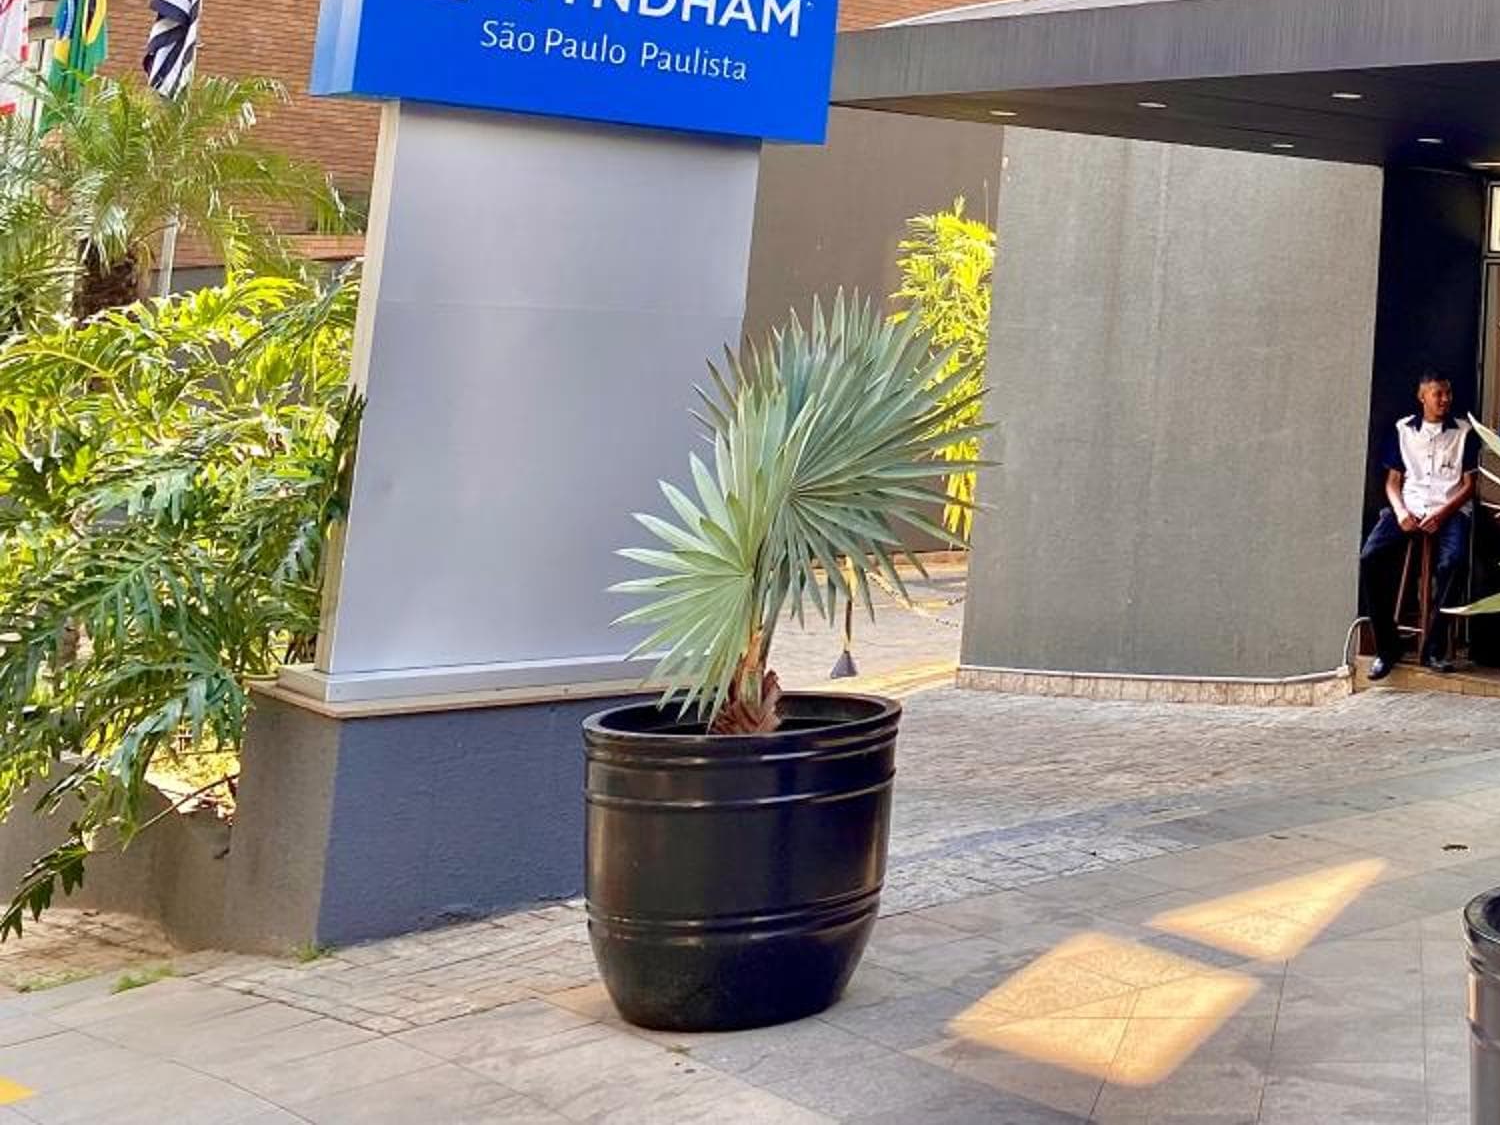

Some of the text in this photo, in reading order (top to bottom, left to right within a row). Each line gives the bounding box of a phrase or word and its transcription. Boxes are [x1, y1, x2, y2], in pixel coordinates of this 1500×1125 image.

[480, 20, 747, 81] São Paulo Paulista
